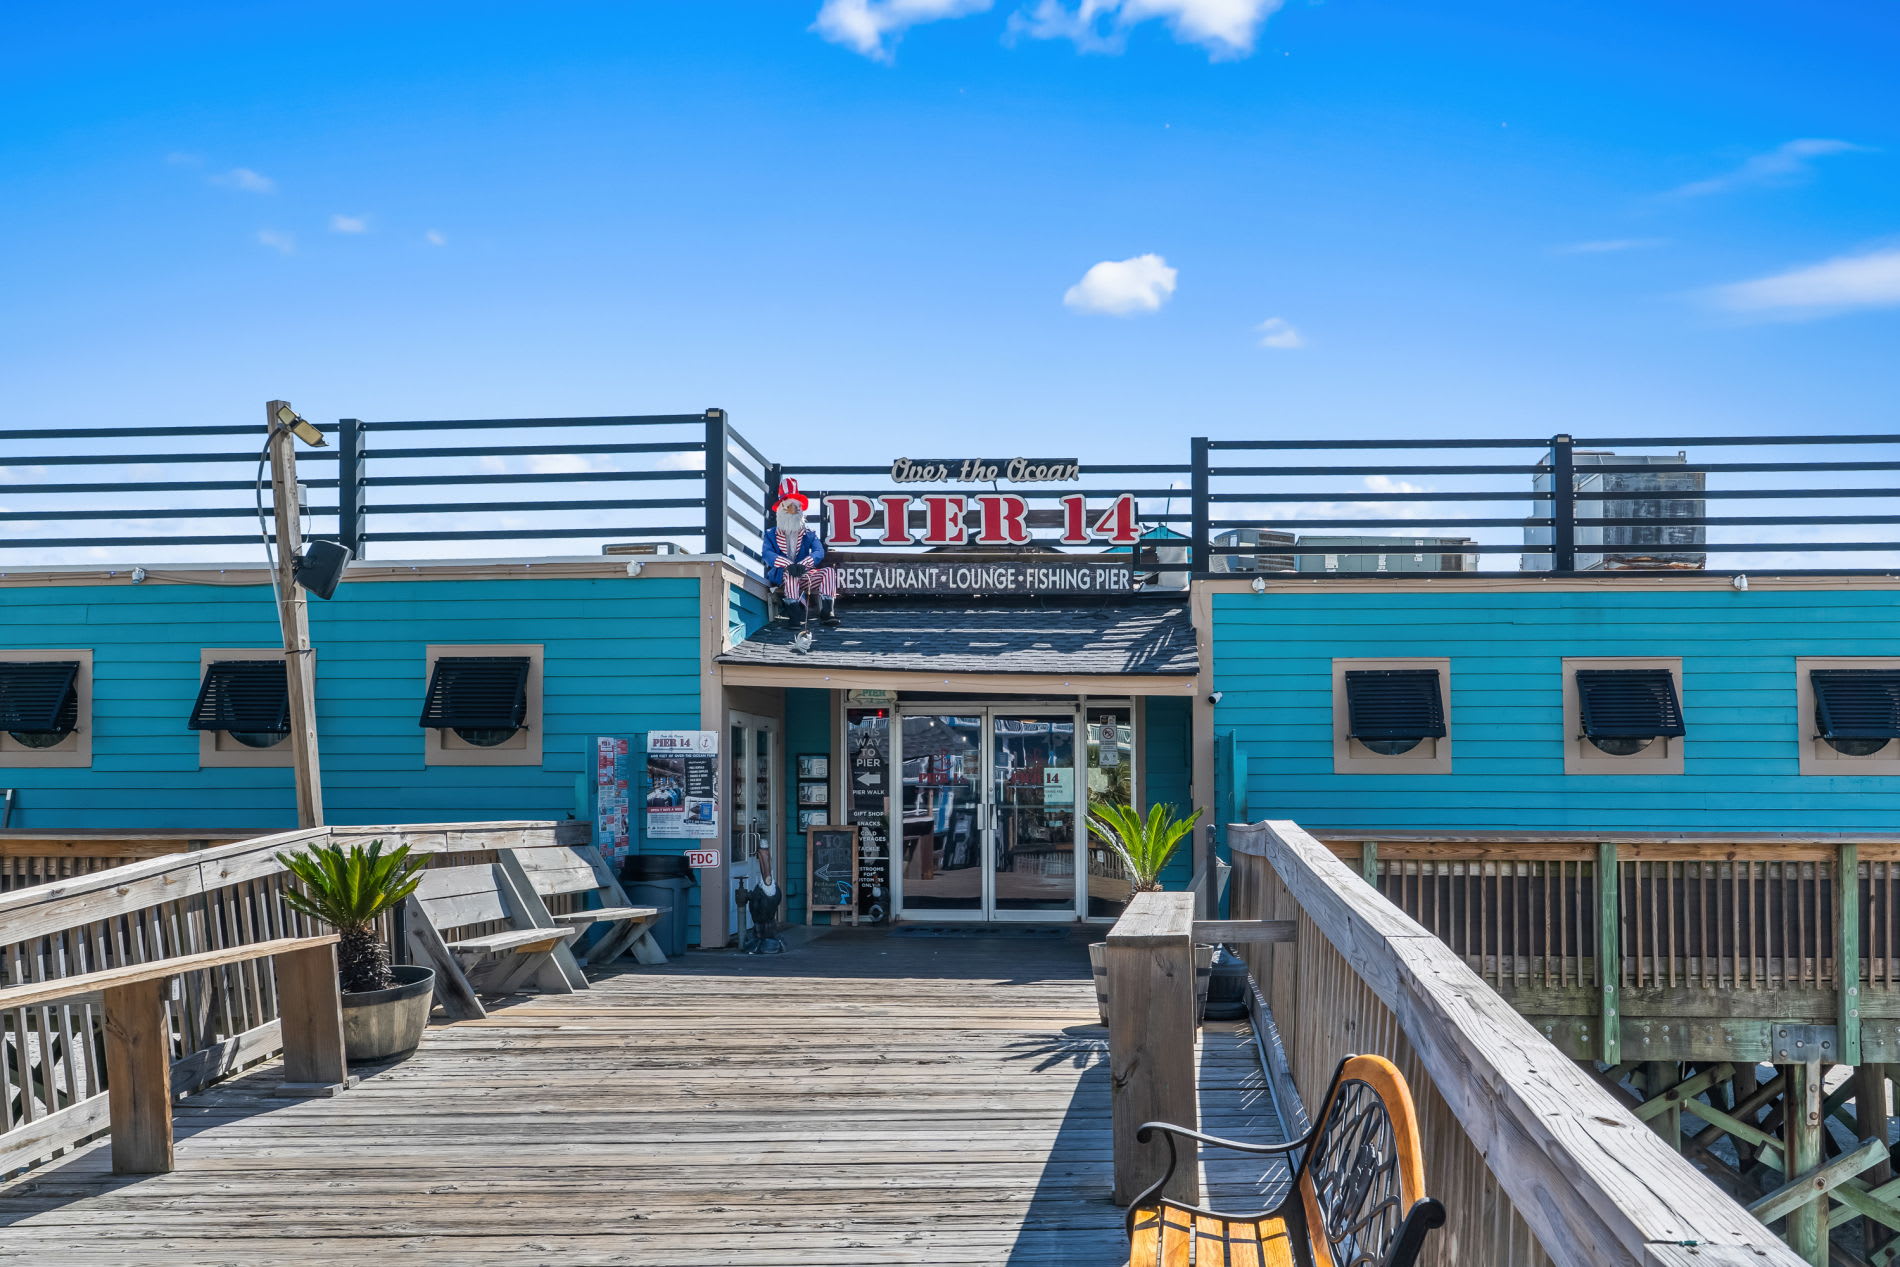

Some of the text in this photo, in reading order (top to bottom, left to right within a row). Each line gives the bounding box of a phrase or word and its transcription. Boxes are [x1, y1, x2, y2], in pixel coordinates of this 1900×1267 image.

[891, 456, 1080, 483] Over the Ocean
[823, 493, 1142, 545] PIER 14
[837, 568, 1130, 590] RESTAURANT LOUNGE FISHING PIER
[858, 728, 880, 736] THIS
[653, 738, 691, 747] PIER 14
[855, 738, 881, 746] WAY
[861, 748, 876, 757] TO
[857, 758, 881, 767] PIER
[1046, 772, 1060, 784] 14
[690, 853, 713, 865] FDC
